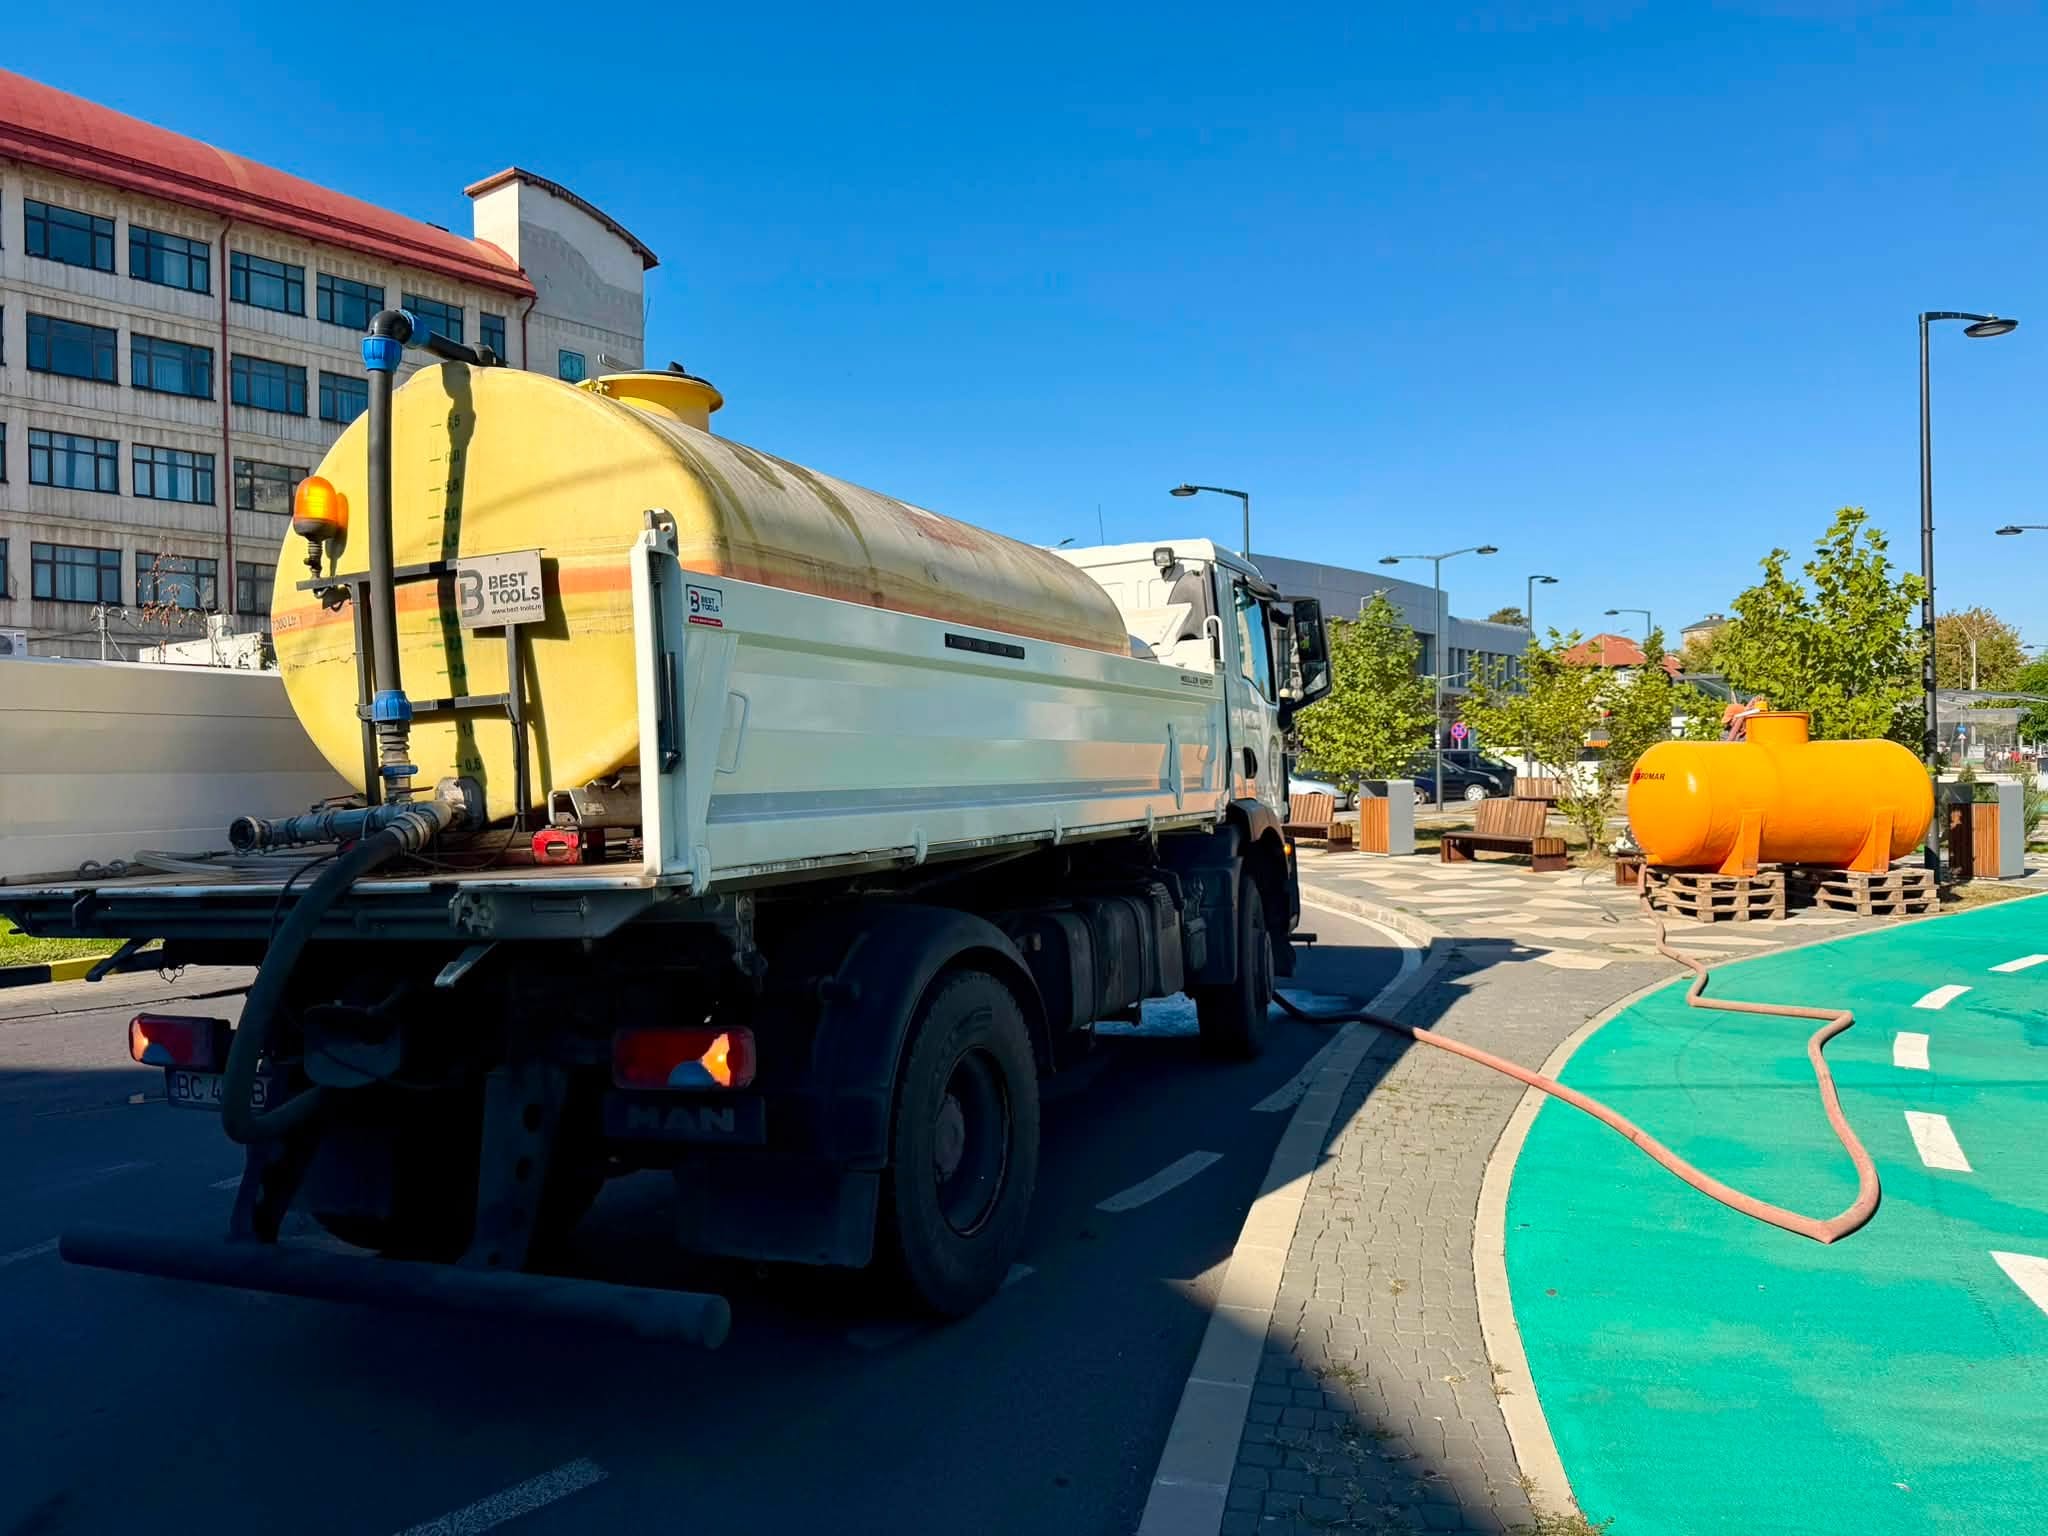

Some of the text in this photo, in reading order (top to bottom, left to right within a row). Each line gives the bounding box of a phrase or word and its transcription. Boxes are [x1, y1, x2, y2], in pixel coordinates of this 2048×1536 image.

[488, 572, 528, 590] BEST
[490, 587, 541, 605] TOOLS
[701, 595, 715, 604] BEST
[702, 603, 719, 612] TOOLS
[178, 1075, 203, 1098] BC
[624, 1105, 736, 1133] MAN
